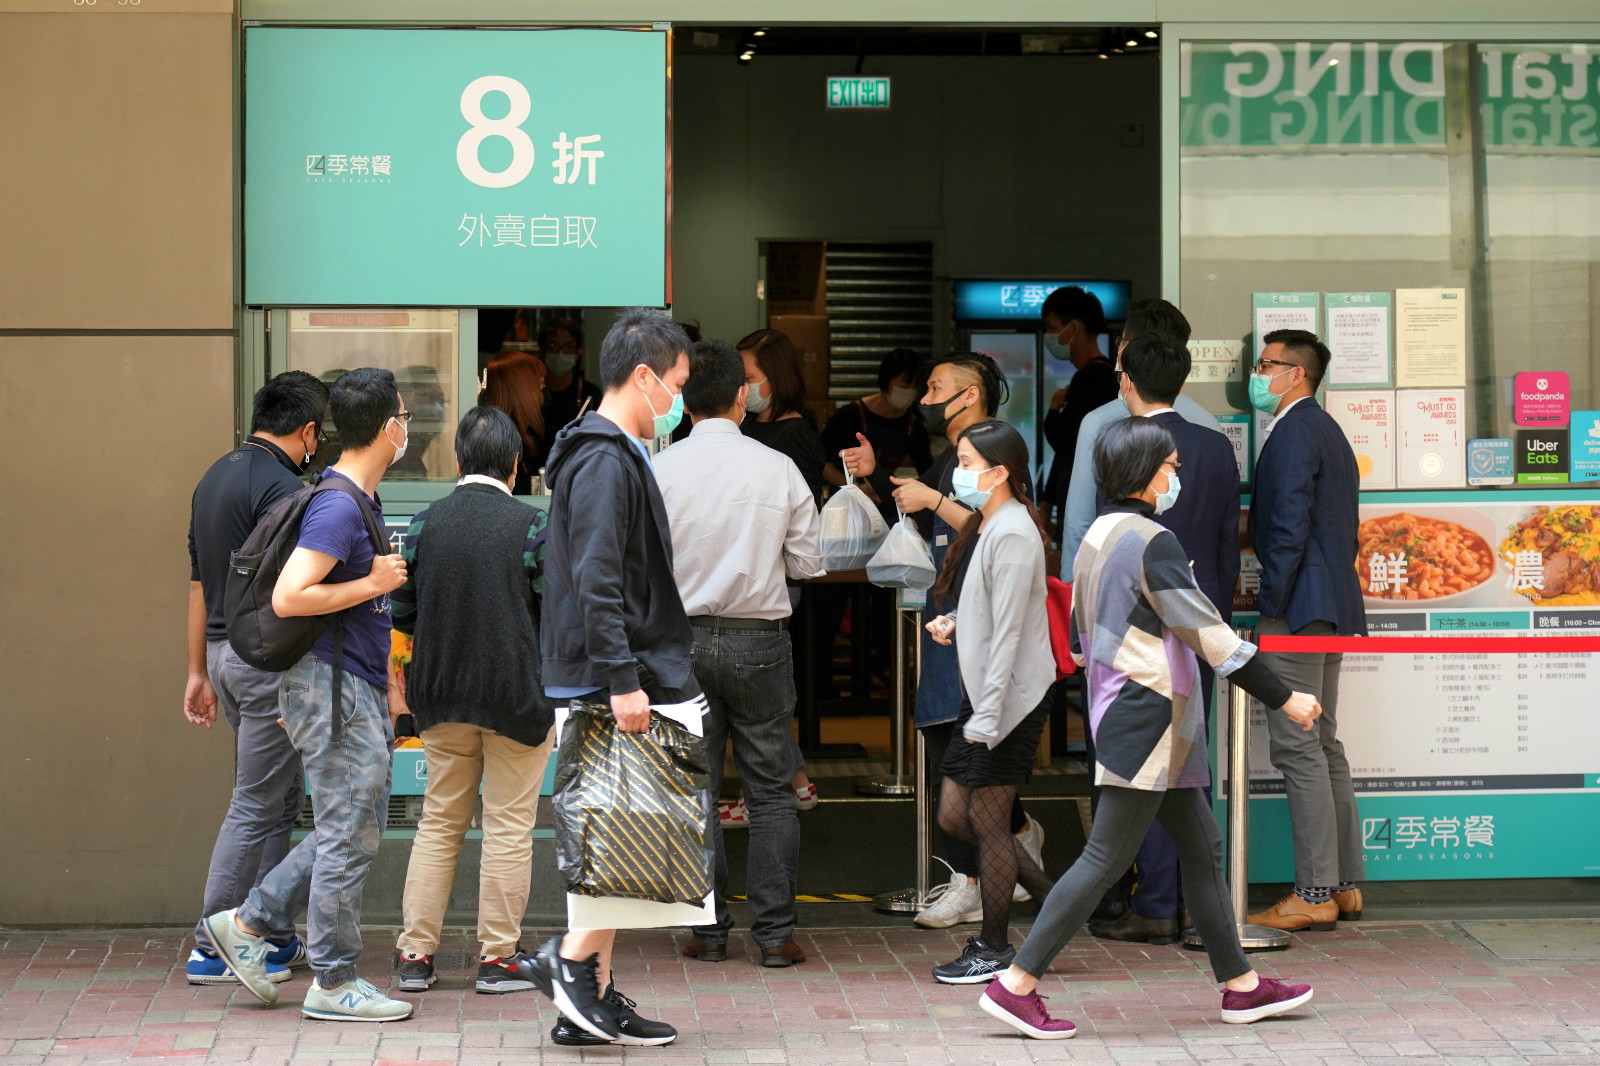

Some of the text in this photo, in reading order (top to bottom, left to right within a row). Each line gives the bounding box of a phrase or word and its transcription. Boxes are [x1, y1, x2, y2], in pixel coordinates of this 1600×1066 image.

[830, 80, 888, 106] EXIT 出口
[306, 154, 392, 176] 四季常餐
[457, 212, 598, 248] 外賣自取
[1190, 346, 1235, 358] OPEN
[1521, 392, 1565, 402] foodpanda
[1527, 439, 1559, 451] Uber
[1527, 452, 1559, 464] Eats
[1368, 552, 1409, 593] 鮮
[1504, 549, 1545, 591] 濃
[1436, 618, 1466, 629] 下午茶
[1539, 616, 1560, 627] 晚餐
[1362, 815, 1495, 849] 四季常餐
[1417, 852, 1494, 860] SEASONS
